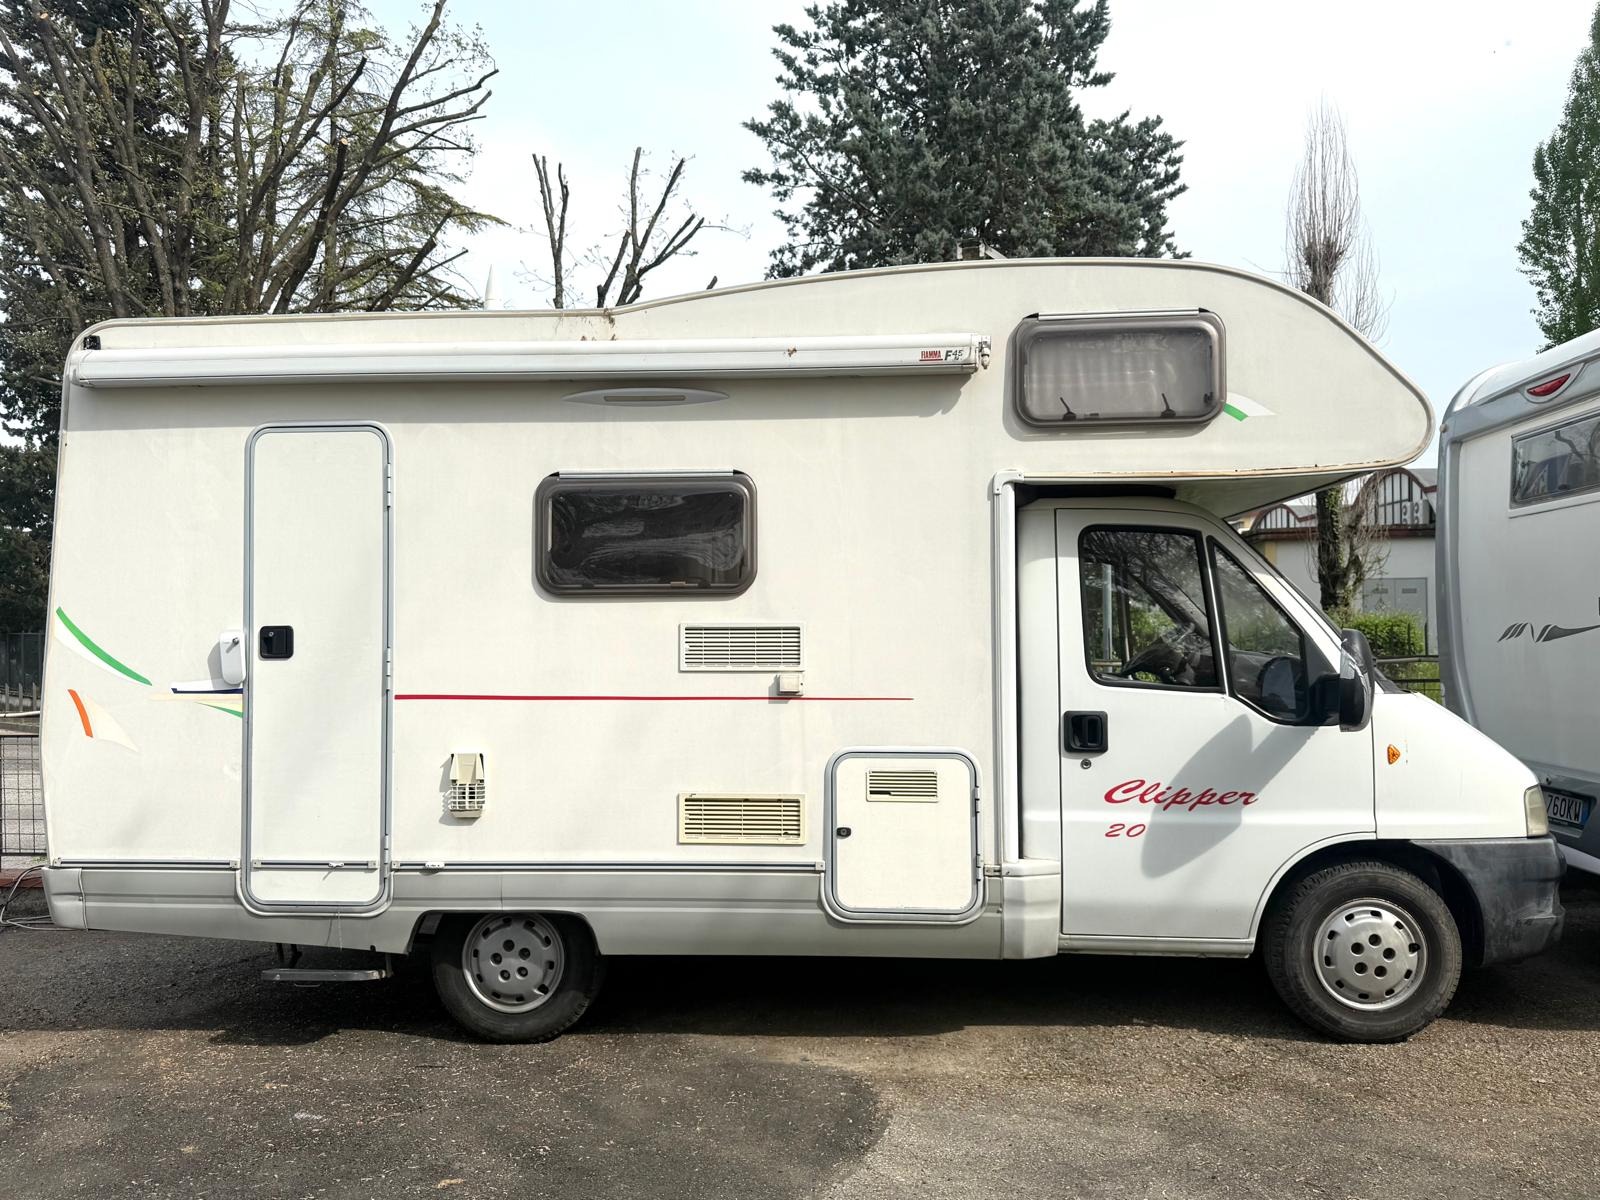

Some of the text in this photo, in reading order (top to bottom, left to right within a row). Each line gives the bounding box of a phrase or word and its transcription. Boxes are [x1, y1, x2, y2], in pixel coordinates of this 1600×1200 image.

[921, 350, 942, 359] FIAMMA
[1103, 779, 1258, 811] Clipper
[1104, 823, 1146, 838] 20
